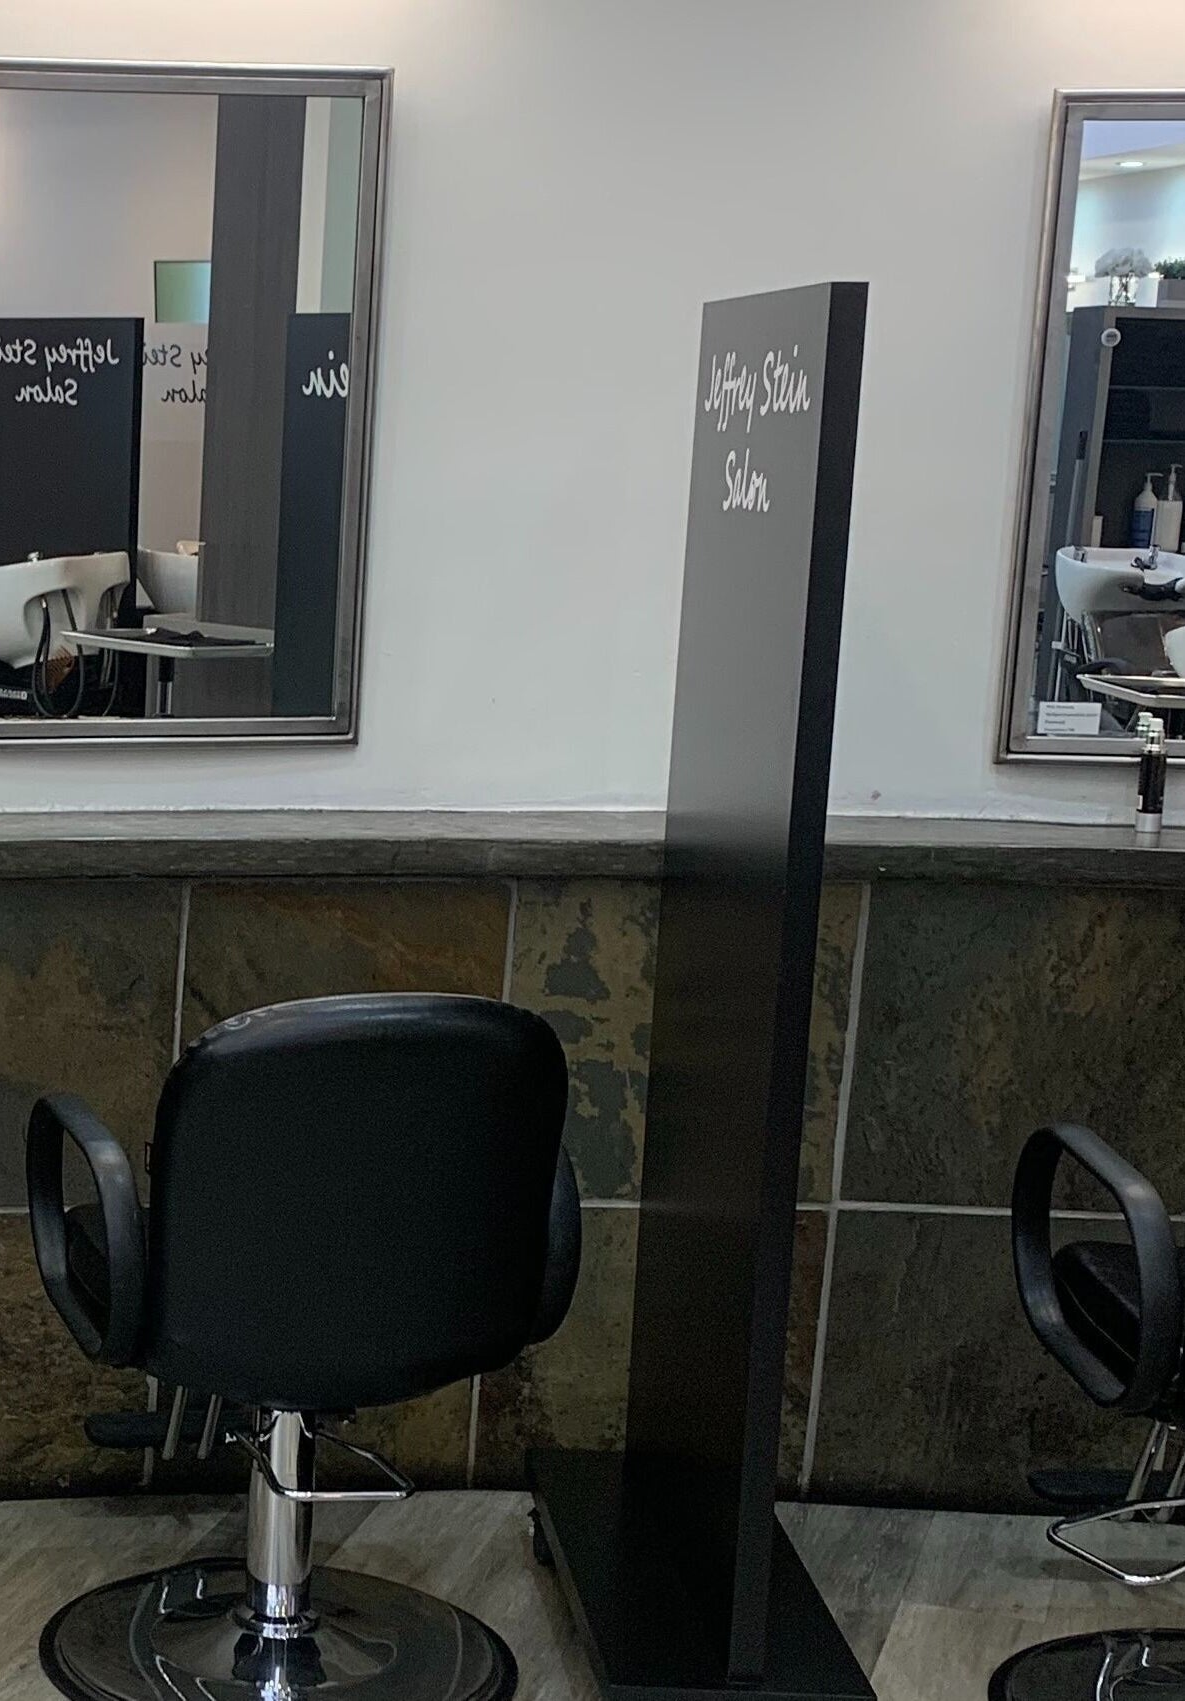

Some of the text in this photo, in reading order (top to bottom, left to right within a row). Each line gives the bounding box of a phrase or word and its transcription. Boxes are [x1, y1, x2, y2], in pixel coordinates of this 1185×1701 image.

[704, 344, 811, 433] Jeffrey Stein
[722, 448, 770, 512] Salon
